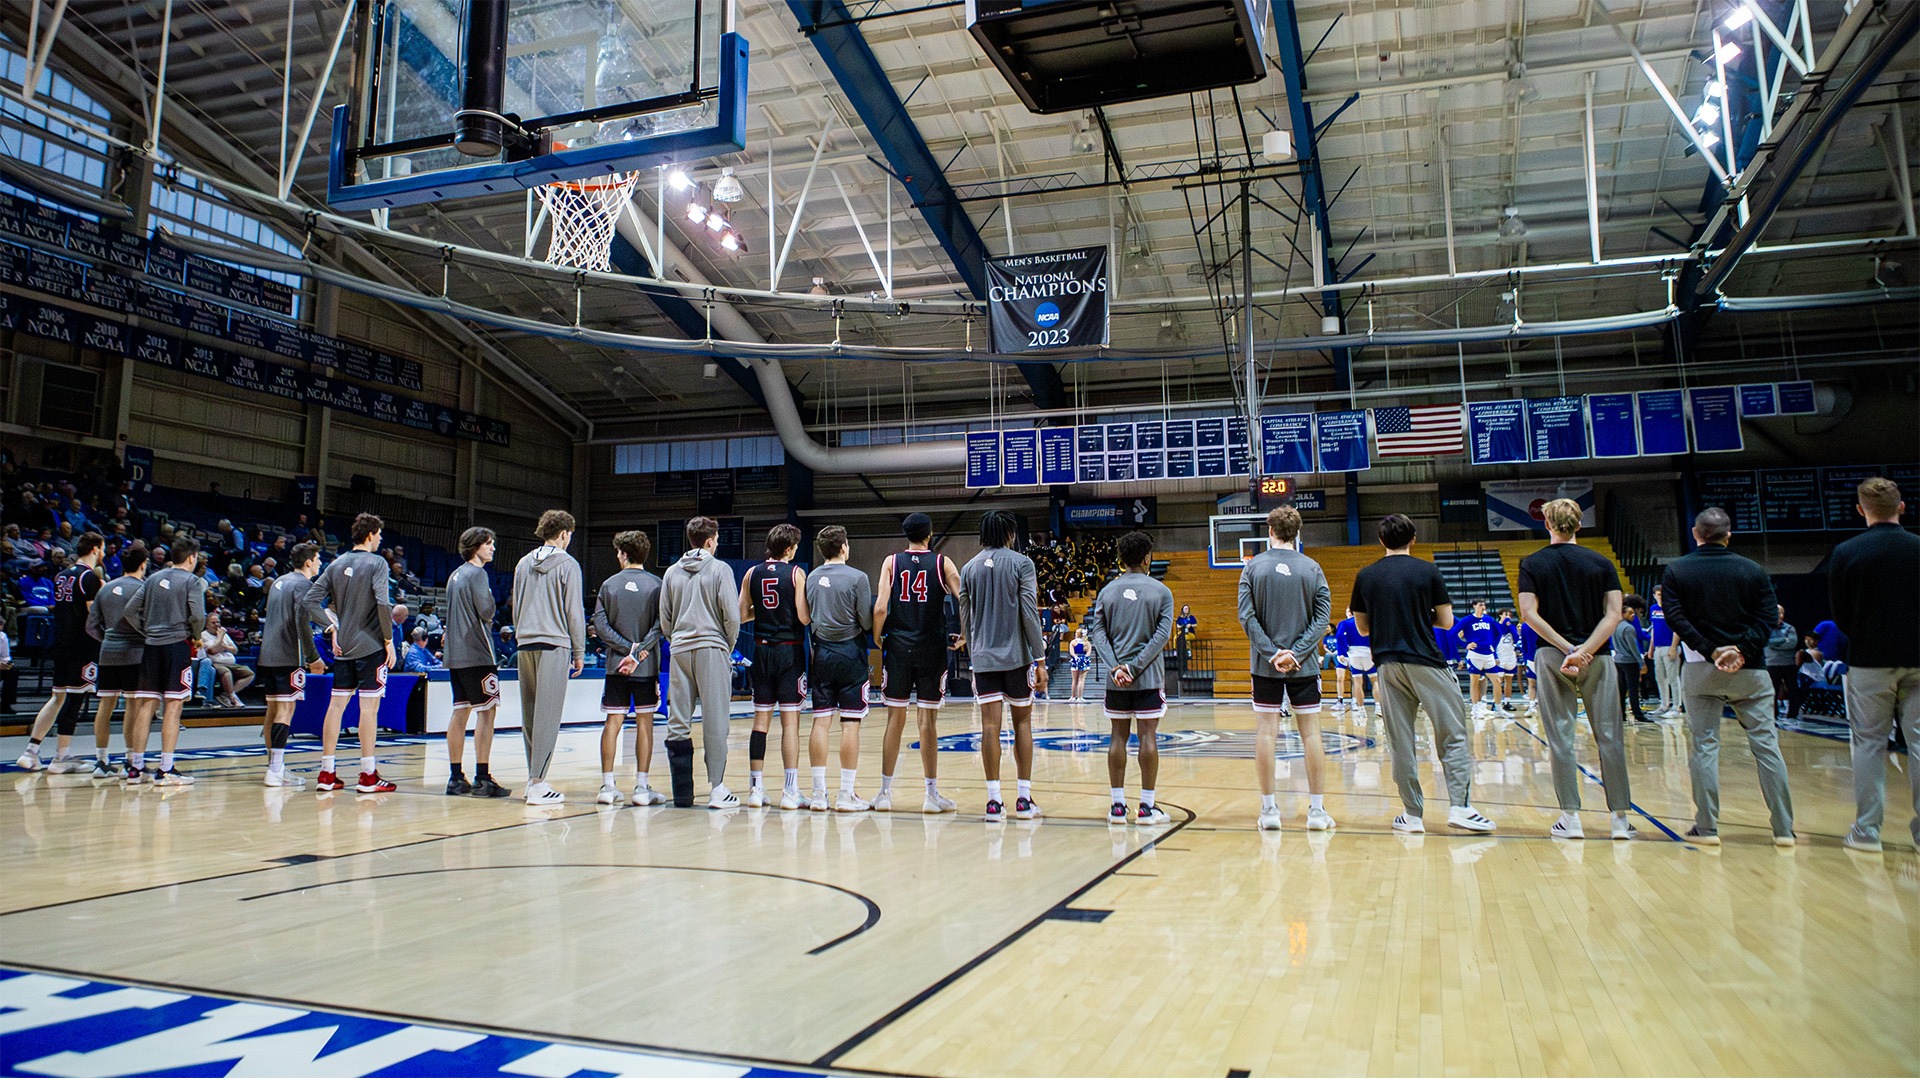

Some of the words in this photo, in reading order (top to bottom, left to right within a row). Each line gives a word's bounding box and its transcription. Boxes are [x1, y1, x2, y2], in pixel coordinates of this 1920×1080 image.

[25, 223, 66, 247] NCAA
[69, 236, 107, 260] NCAA
[110, 249, 146, 272] NCAA
[1005, 256, 1032, 267] MEN'S
[1035, 251, 1087, 264] BASKETBALL
[149, 262, 182, 283] NCAA
[1014, 271, 1077, 286] NATIONAL
[27, 276, 68, 295] SWEET
[106, 273, 136, 289] NCAA
[229, 287, 260, 306] NCAA
[989, 277, 1107, 302] CHAMPIONS
[84, 292, 123, 309] SWEET
[38, 307, 66, 325] 2006
[1037, 313, 1060, 322] NCAA
[27, 318, 71, 342] NCAA
[94, 321, 119, 338] 2010
[84, 332, 124, 353] NCAA
[145, 334, 168, 350] 2012
[1028, 329, 1070, 347] 2023
[137, 345, 173, 365] NCAA
[184, 357, 219, 377] NCAA
[232, 365, 259, 382] NCAA
[276, 376, 298, 389] NCAA
[399, 377, 421, 391] NCAA
[269, 385, 295, 399] SWEET
[306, 387, 333, 403] NCAA
[342, 392, 363, 405] NCAA
[374, 401, 398, 415] NCAA
[405, 409, 429, 422] NCAA
[485, 431, 508, 446] NCAA
[132, 465, 144, 481] D
[1261, 480, 1286, 493] 22.0
[303, 491, 311, 505] E
[1071, 508, 1116, 518] CHAMPIONS
[1223, 506, 1251, 514] UNITED
[761, 578, 778, 609] 5
[900, 570, 927, 602] 14
[1472, 622, 1490, 631] CNU
[489, 679, 496, 690] S
